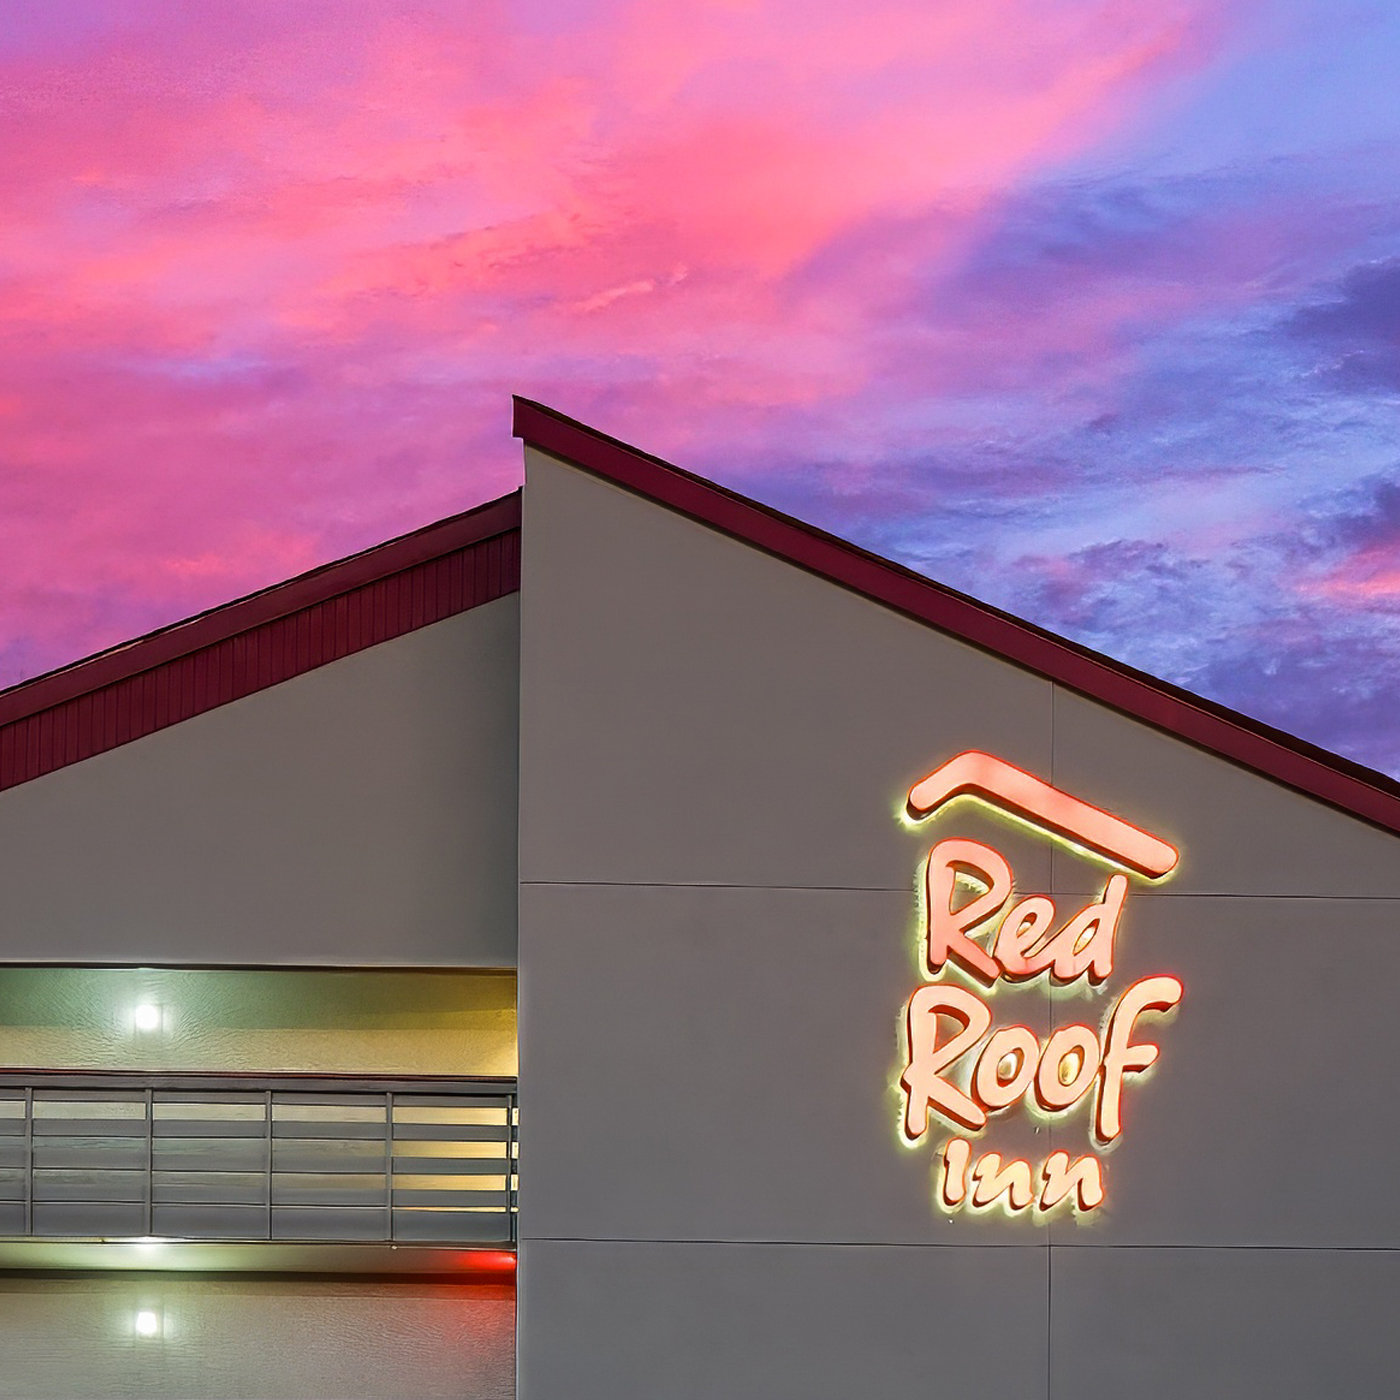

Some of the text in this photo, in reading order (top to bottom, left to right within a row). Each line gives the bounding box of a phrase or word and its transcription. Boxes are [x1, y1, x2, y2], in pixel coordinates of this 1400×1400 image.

[926, 838, 1128, 988] Red
[900, 975, 1184, 1142] Roof
[943, 1137, 1104, 1212] Inn
